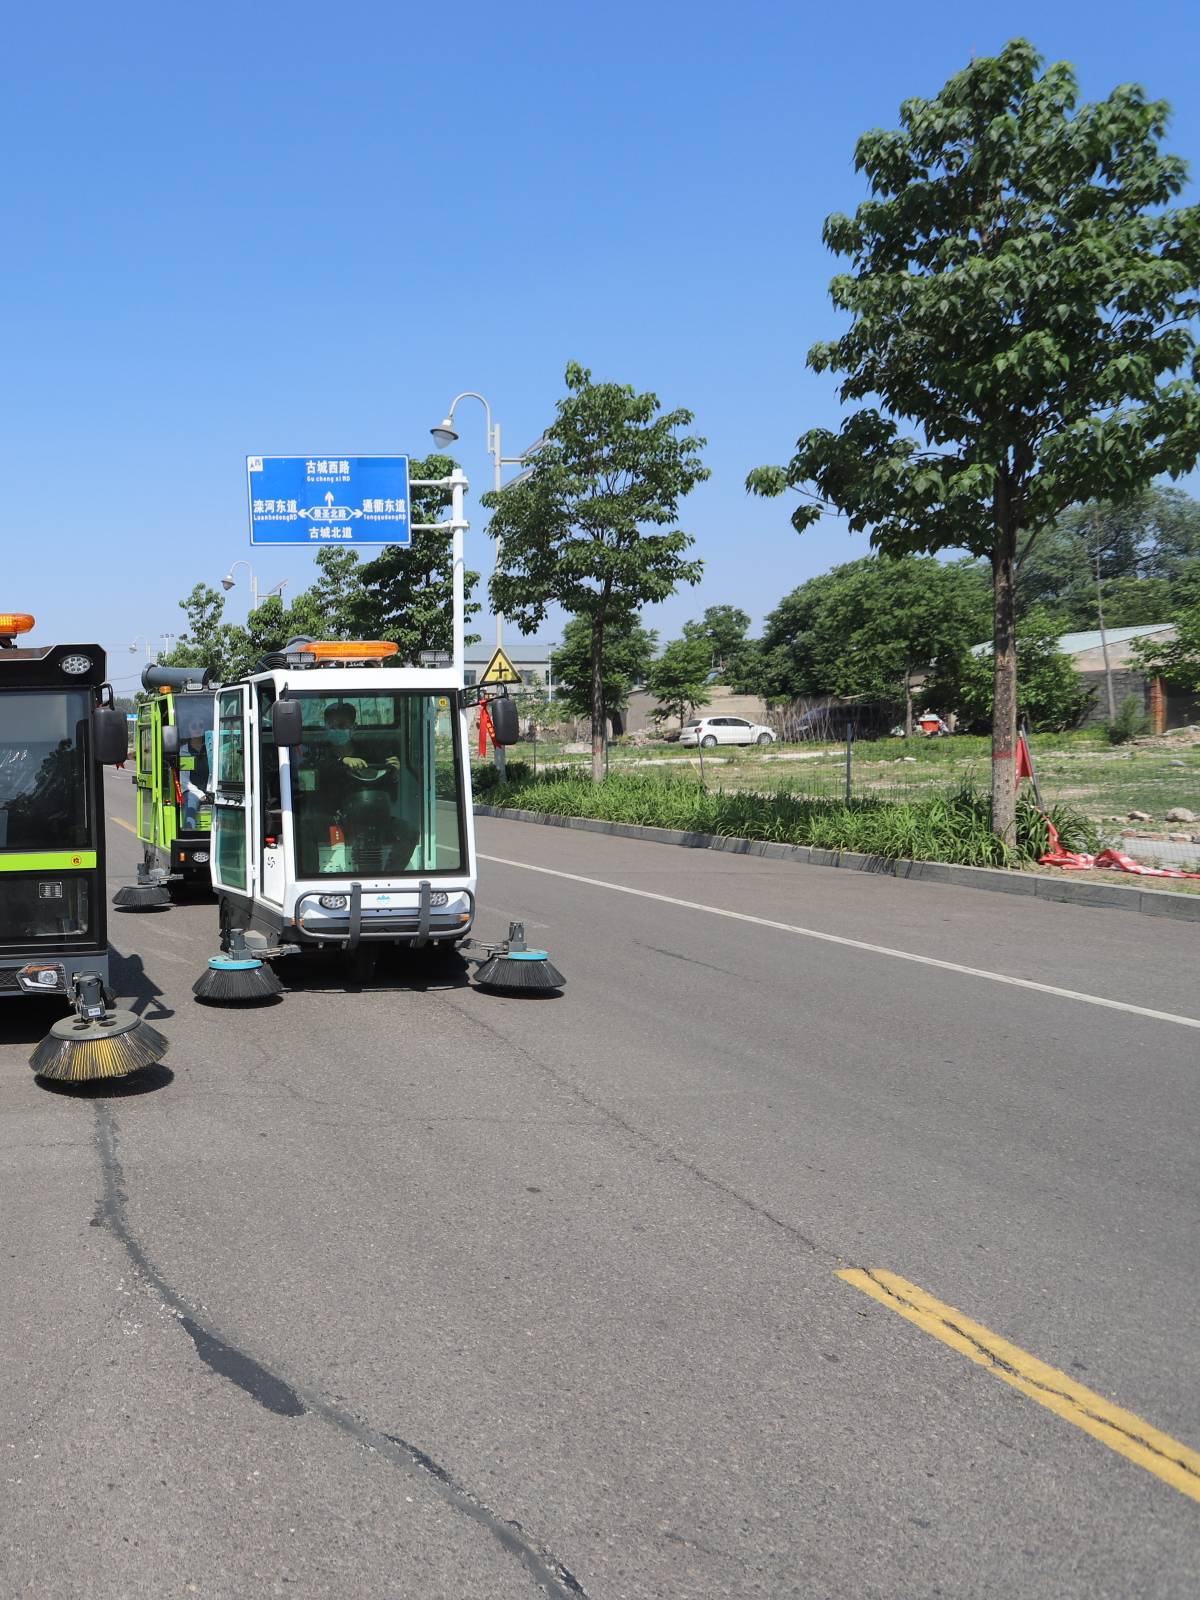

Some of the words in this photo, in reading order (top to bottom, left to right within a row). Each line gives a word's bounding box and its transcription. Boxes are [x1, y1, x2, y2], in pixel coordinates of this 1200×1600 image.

[306, 460, 349, 474] 古城西路
[253, 499, 298, 513] 滦河东道
[308, 527, 353, 539] 古城北道
